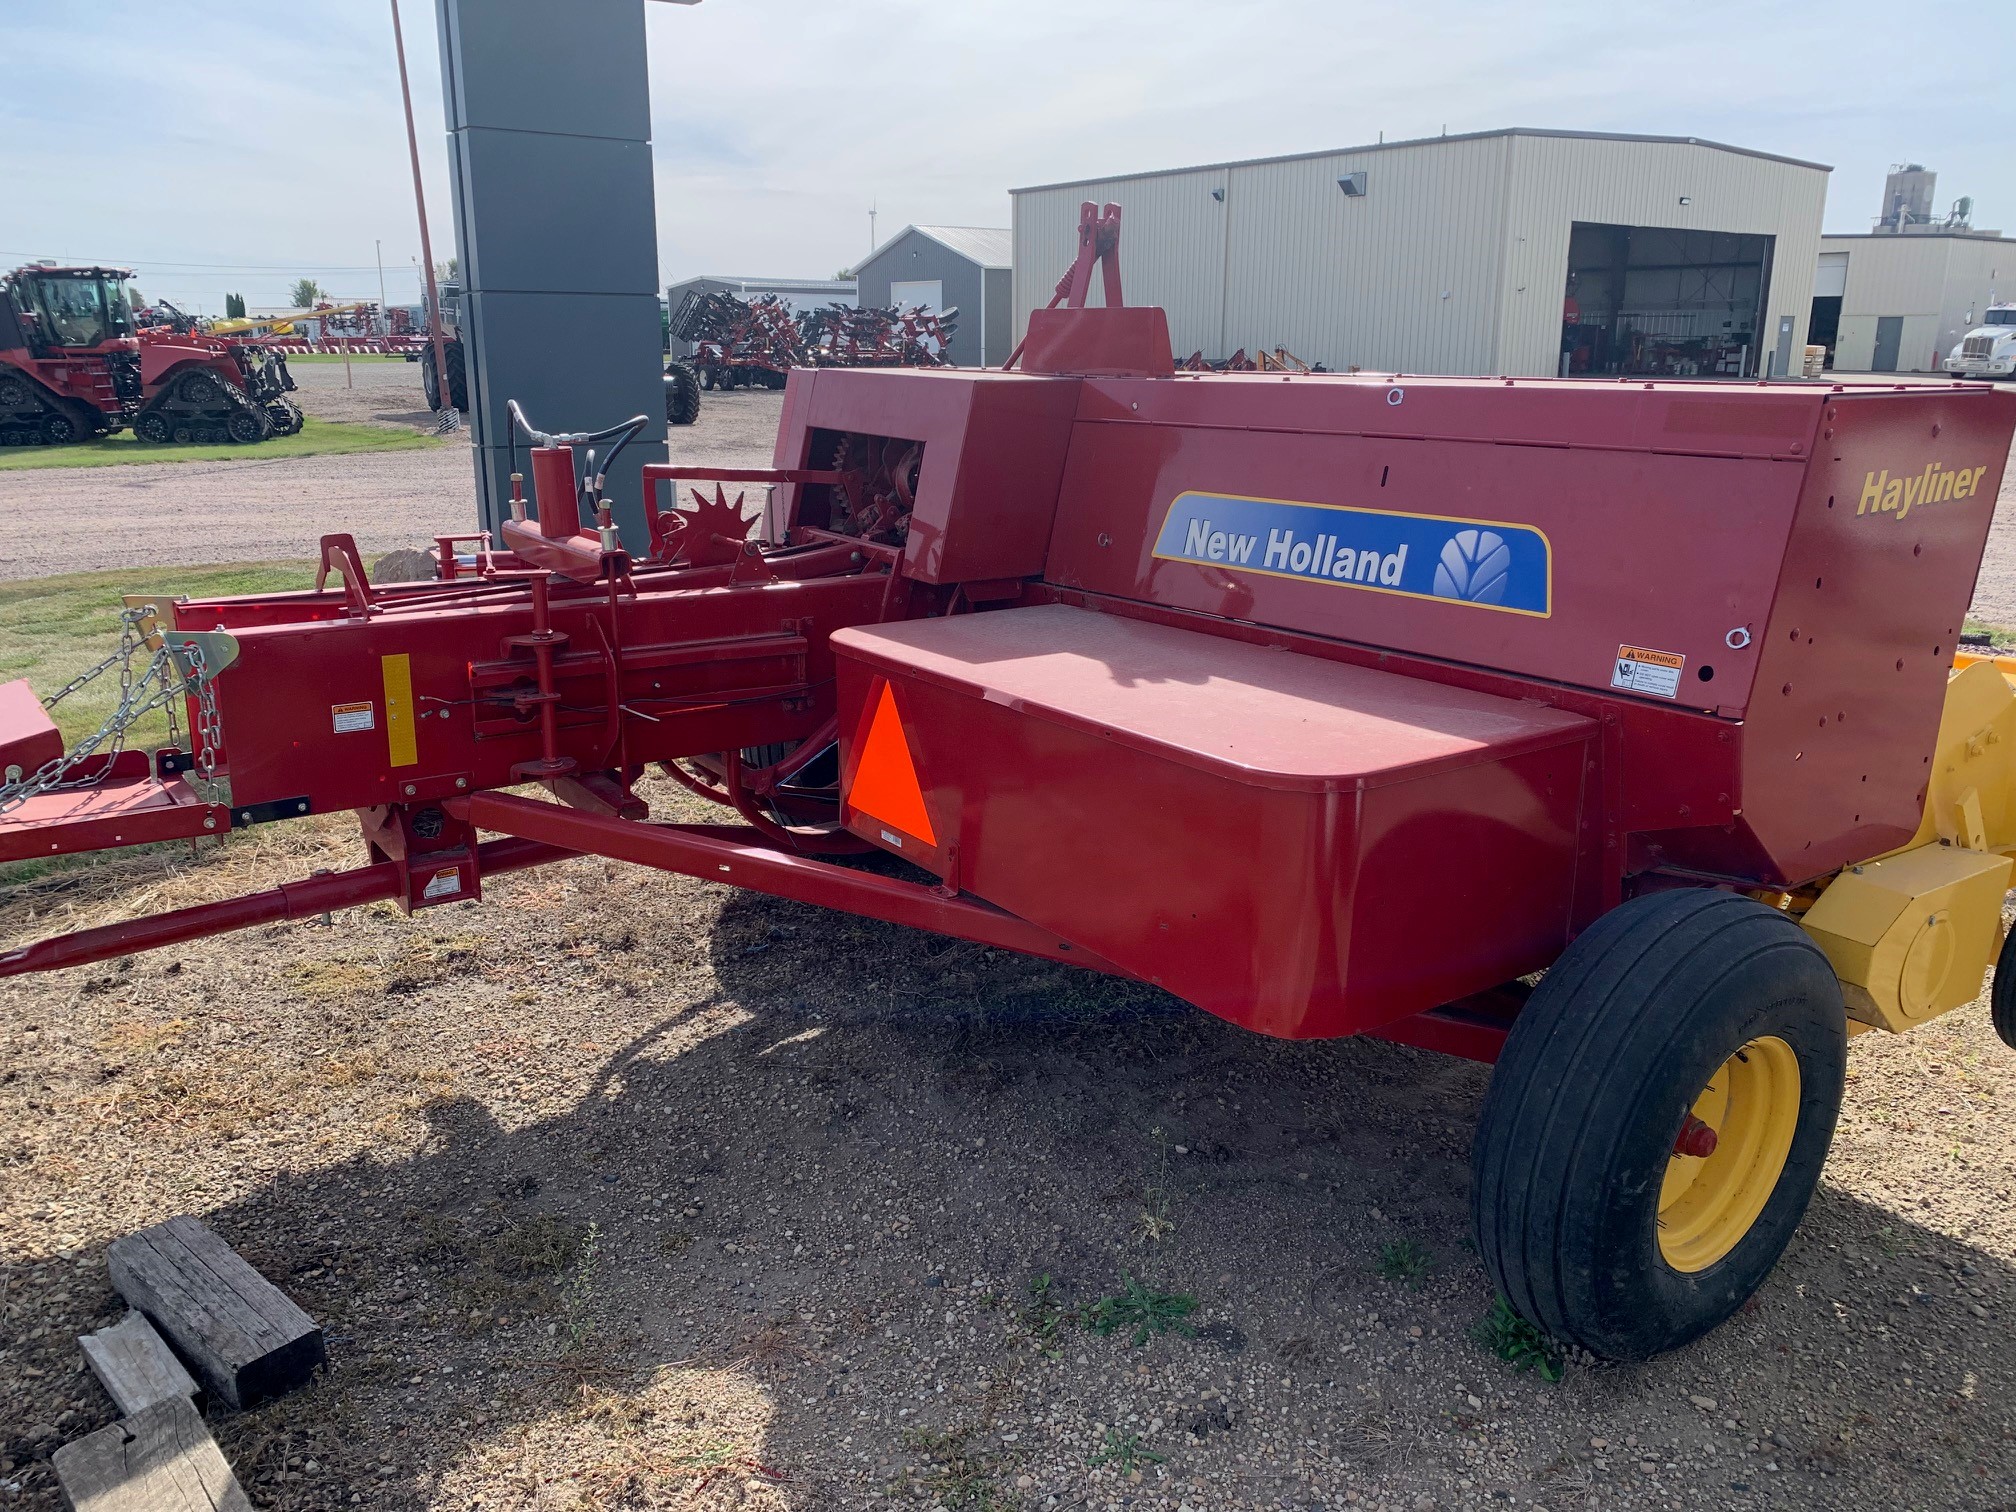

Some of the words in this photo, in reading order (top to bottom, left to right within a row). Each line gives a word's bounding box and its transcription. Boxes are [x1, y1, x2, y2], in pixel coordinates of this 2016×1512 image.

[1856, 462, 1987, 520] Hayliner
[1183, 518, 1257, 563] New
[1262, 528, 1408, 586] Holland
[1636, 651, 1678, 664] WARNING
